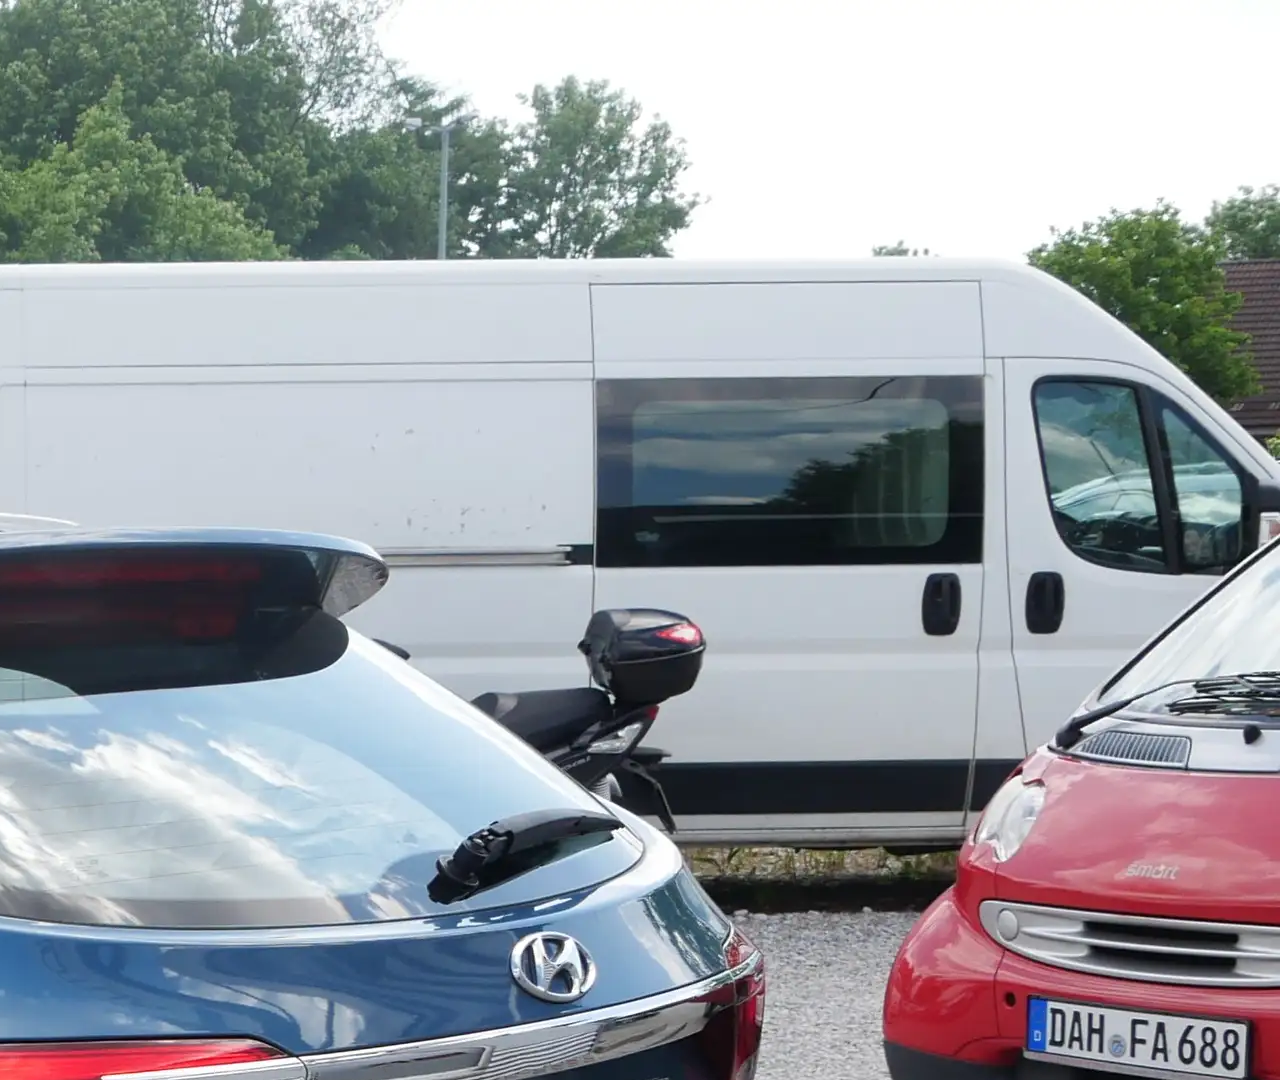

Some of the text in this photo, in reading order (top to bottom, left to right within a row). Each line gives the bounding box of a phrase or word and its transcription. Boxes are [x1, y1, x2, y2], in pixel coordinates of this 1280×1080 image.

[1127, 863, 1180, 880] smart
[1049, 1007, 1240, 1071] DAH FA 688
